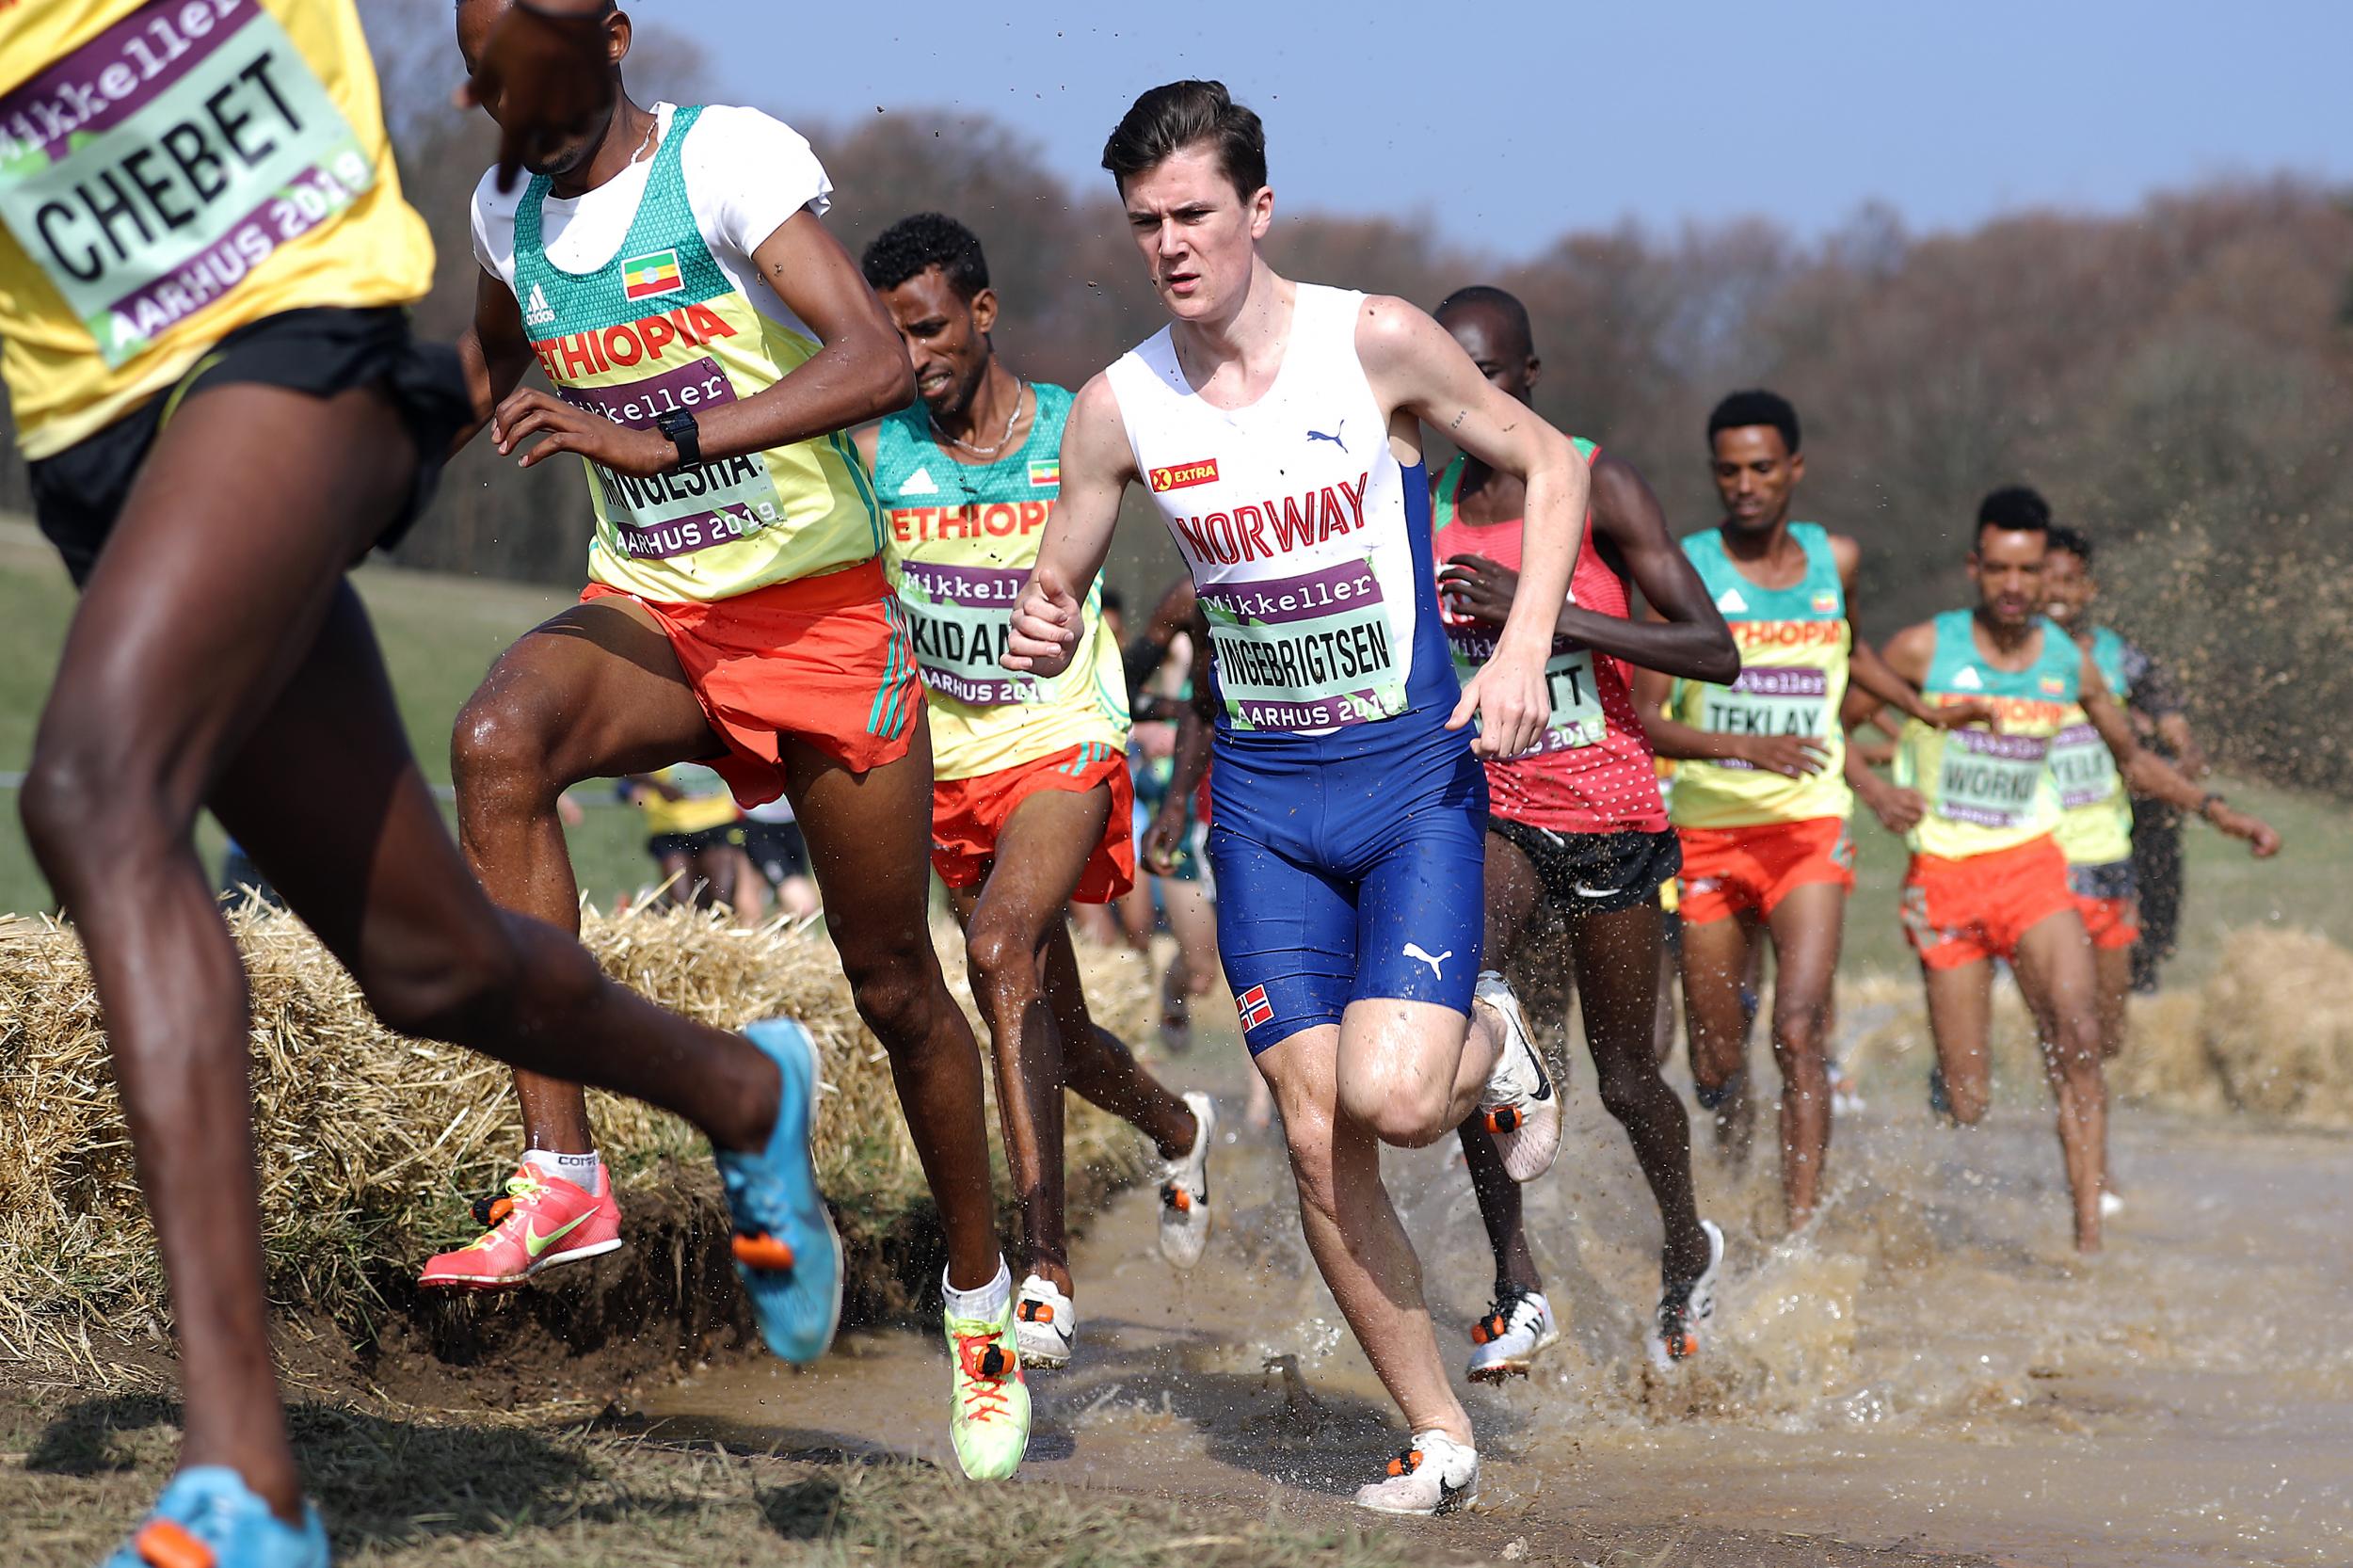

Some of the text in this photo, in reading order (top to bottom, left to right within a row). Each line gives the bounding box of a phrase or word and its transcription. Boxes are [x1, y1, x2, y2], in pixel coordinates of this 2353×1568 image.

[36, 52, 302, 283] CHEBET
[111, 152, 368, 351] AARHUS 2019
[526, 308, 555, 327] adidas
[531, 303, 738, 380] ETHIOPIA
[1175, 465, 1216, 483] EXTRA
[616, 502, 776, 555] AARHUS 2019
[891, 500, 1056, 542] ETHIOP
[1175, 472, 1369, 565] NORWAY
[904, 570, 1018, 600] Mikkell
[1202, 574, 1372, 616] Mikkeller
[1219, 620, 1391, 688] INGEBRIGTSEN
[920, 667, 993, 702] AARHUS
[1237, 706, 1330, 727] AARHUS
